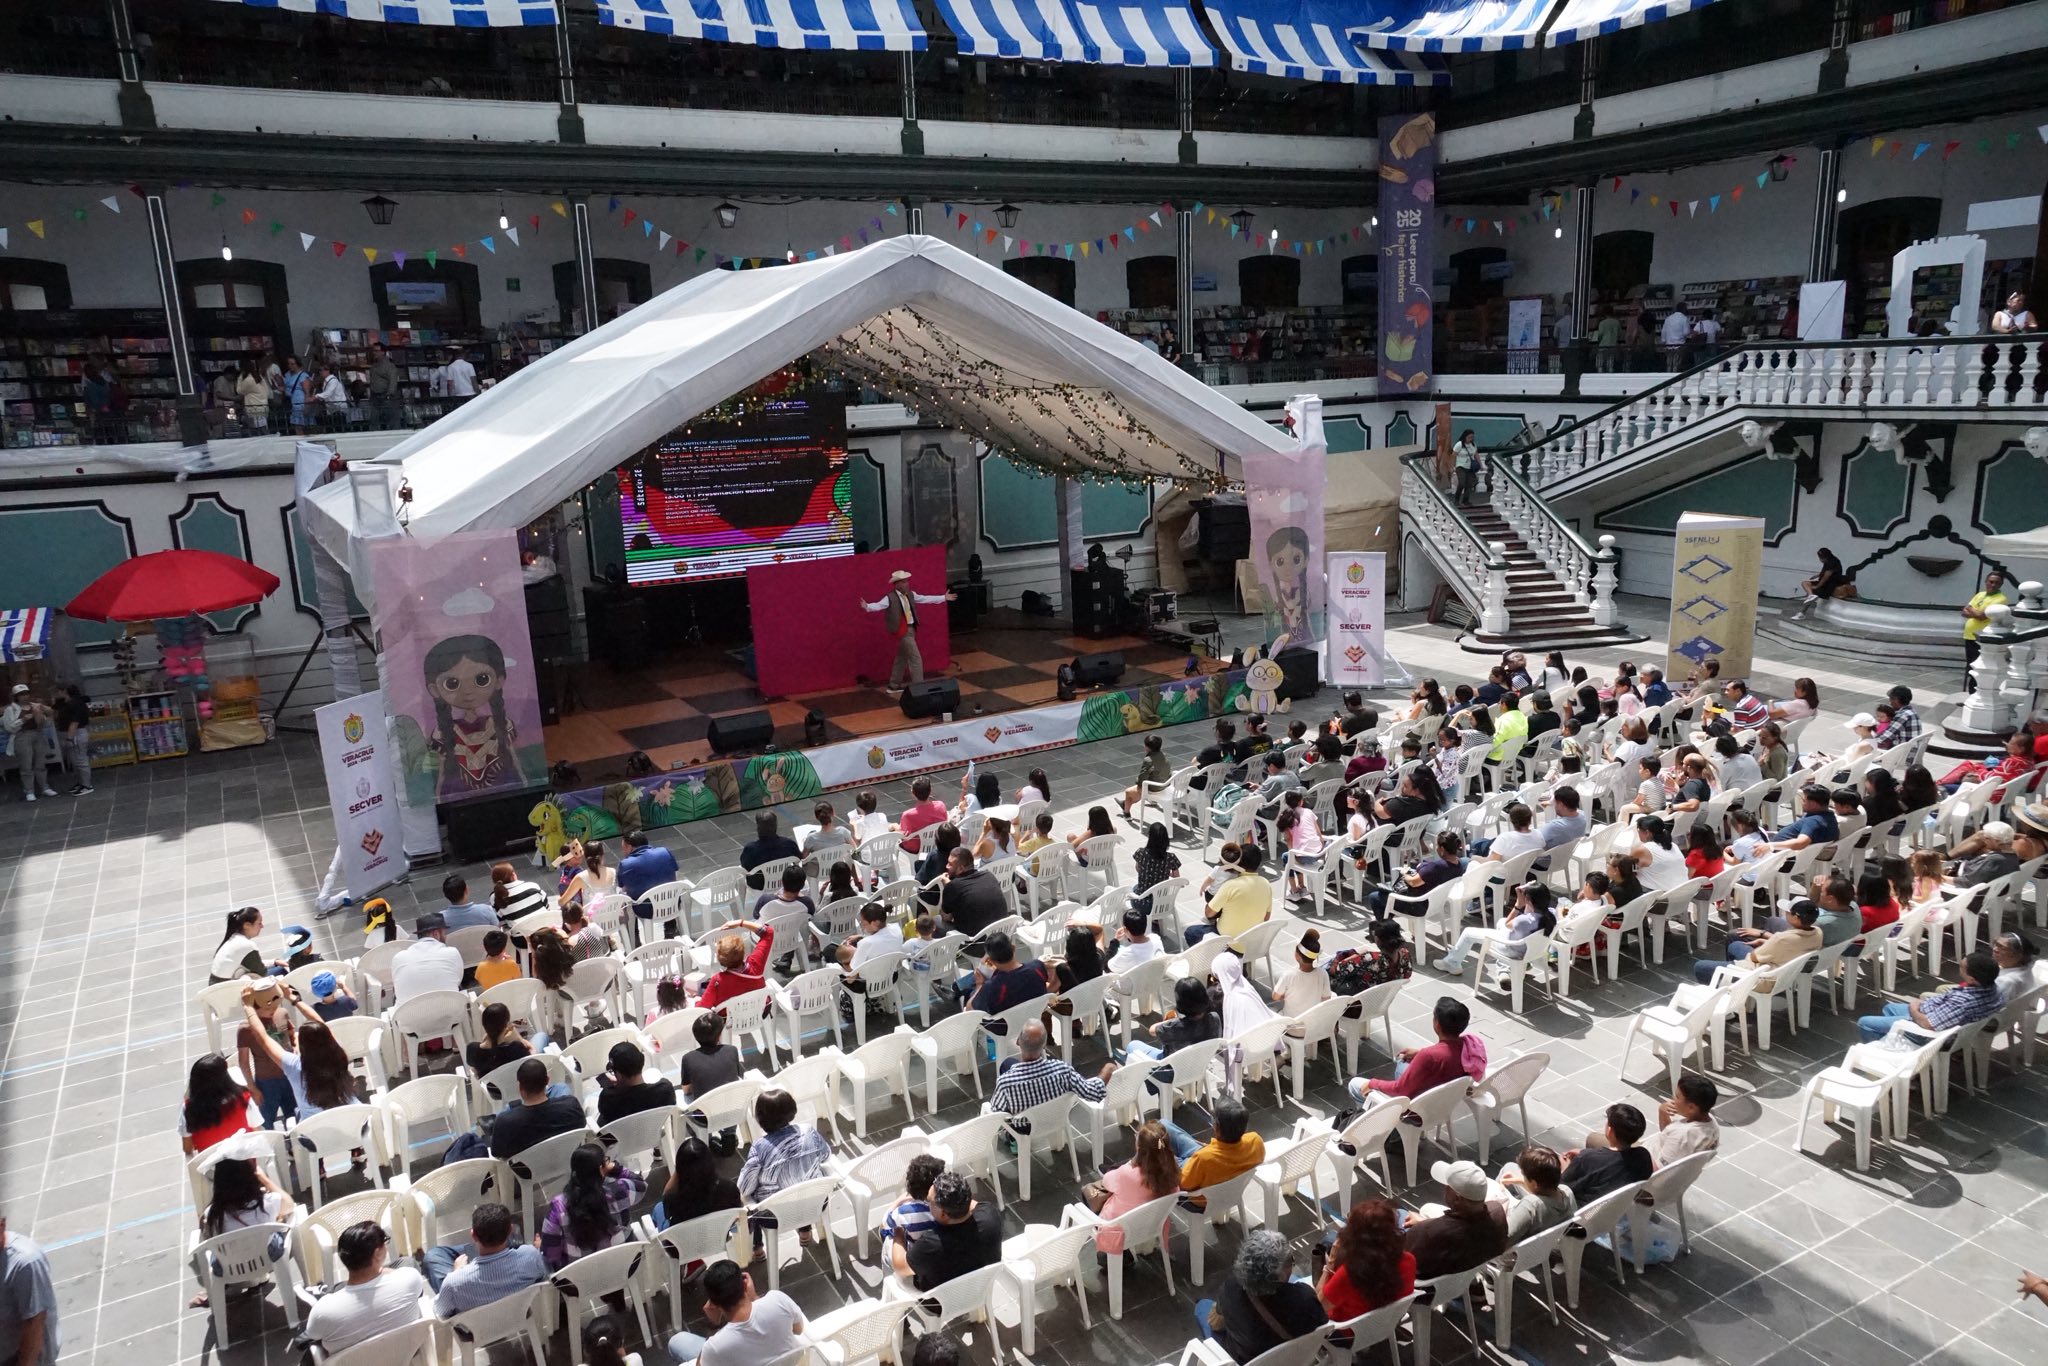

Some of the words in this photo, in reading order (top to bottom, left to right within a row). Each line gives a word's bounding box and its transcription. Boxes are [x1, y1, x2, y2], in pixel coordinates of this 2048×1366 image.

[1397, 210, 1409, 228] 25
[1409, 209, 1422, 227] 20
[1410, 233, 1419, 256] Leer
[1398, 260, 1407, 303] historias
[1004, 726, 1034, 736] VERACRUZ
[932, 736, 959, 747] SECVER
[341, 747, 374, 764] VERACRUZ
[889, 746, 923, 757] VERACRUZ
[348, 794, 383, 815] SECVER
[364, 856, 388, 872] VERACRUZ
